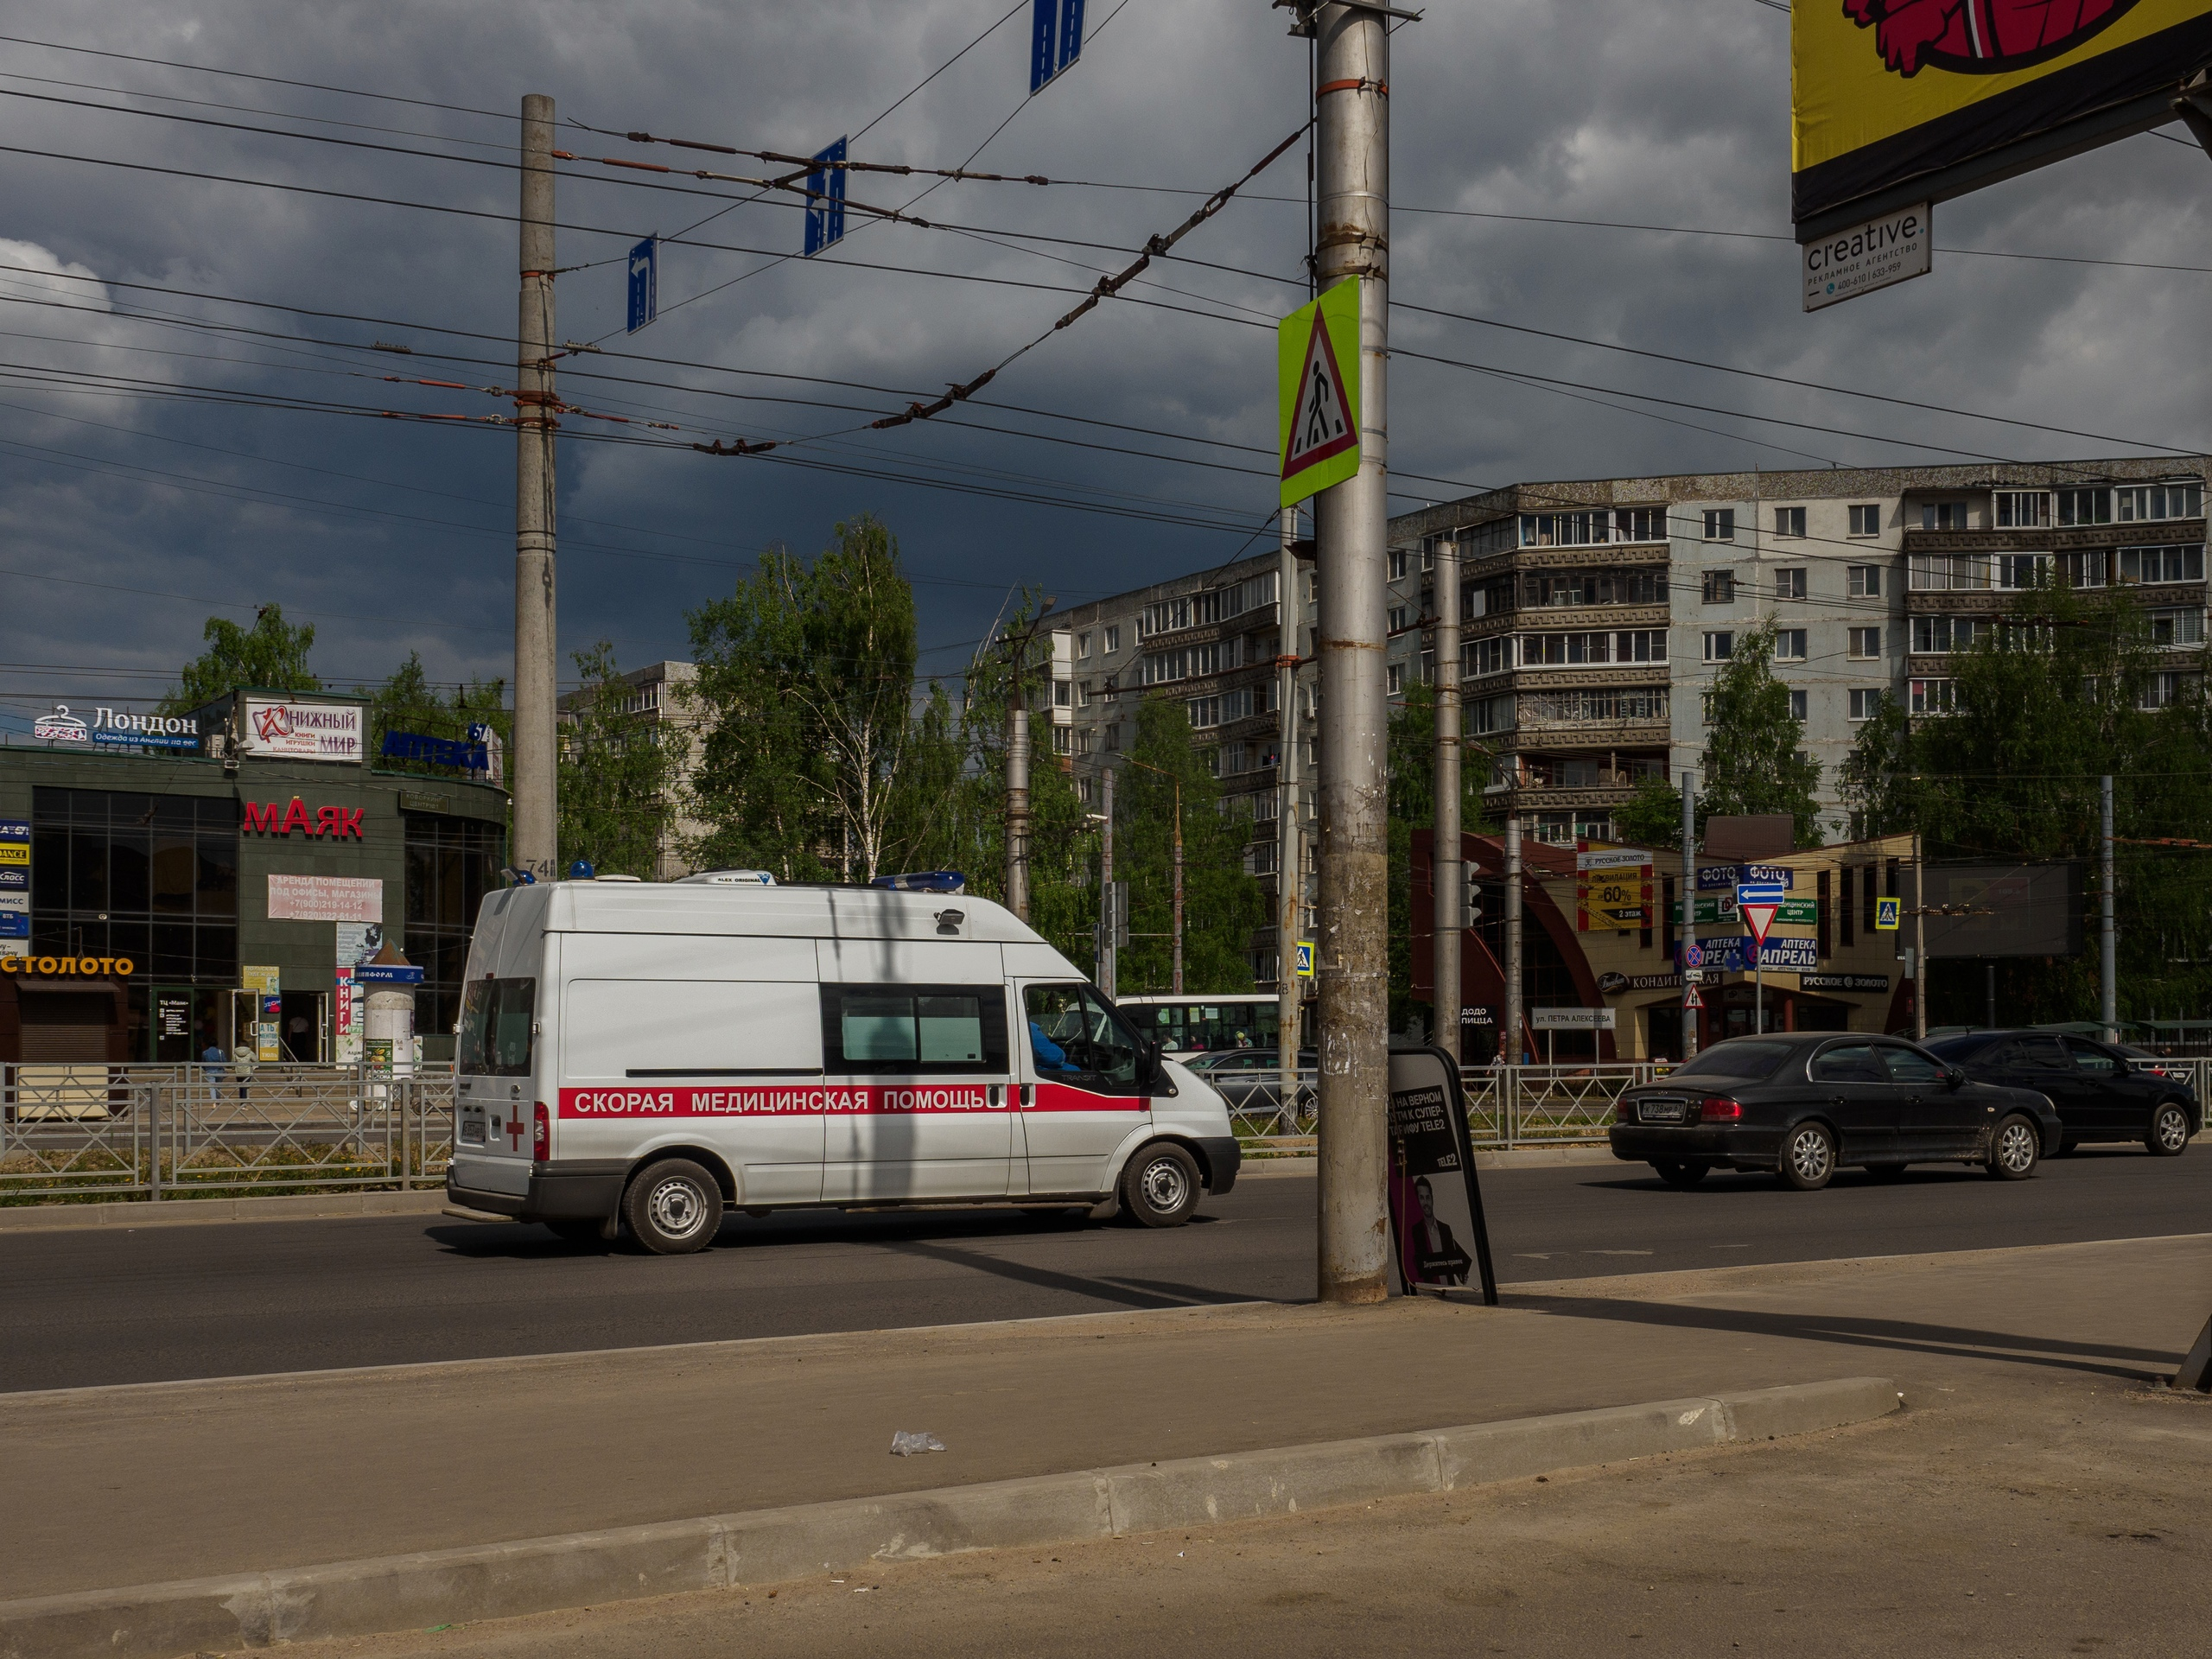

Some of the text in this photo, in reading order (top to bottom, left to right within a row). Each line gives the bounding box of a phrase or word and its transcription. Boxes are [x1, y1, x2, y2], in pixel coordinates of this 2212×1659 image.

[1808, 243, 1917, 286] РЕКЛАМНОЕ АГЕНТСТВО
[1837, 273, 1866, 290] 400-610
[1872, 262, 1902, 280] 633-959
[93, 707, 199, 736] Лондон
[96, 734, 128, 743] Одежда
[129, 734, 139, 743] из
[139, 736, 170, 746] Англии
[321, 735, 357, 756] МИР
[380, 729, 489, 771] АПТЕКА
[1595, 854, 1644, 865] РУССКОЕ ЗОЛОТО
[1592, 873, 1637, 883] ЛВИДАЦИЯ
[1702, 867, 1736, 881] ФОТО
[1750, 866, 1785, 880] ФОТО
[276, 875, 314, 887] АРЕНДА
[270, 887, 381, 900] ПОД ОФИСЫ, МАГАЗИНЫ
[1603, 886, 1631, 903] 60%
[289, 899, 363, 910] +7(900)219-14-12
[1706, 938, 1740, 950] АПТЕКА
[1781, 938, 1816, 950] АПТЕКА
[1761, 949, 1816, 965] АПРЕЛЬ
[1, 955, 134, 976] СТОЛОТО
[1802, 976, 1888, 988] РУССКОЕ ЗОЛОТО
[340, 976, 351, 1034] КНИГИ
[1461, 1007, 1486, 1016] ДОДО
[1461, 1017, 1492, 1026] ПИЦЦА
[1571, 1014, 1611, 1023] АЛЕКСЕЕВА
[575, 1090, 985, 1114] СКОРАЯ МЕДИЦИНСКАЯ ПОМОЩЬ
[1395, 1096, 1408, 1109] НА
[1408, 1090, 1443, 1107] ВЕРНОМ
[1408, 1110, 1415, 1120] К
[1414, 1105, 1444, 1120] СУПЕР-
[1420, 1118, 1446, 1133] TELE2
[1436, 1153, 1458, 1168] TELE2
